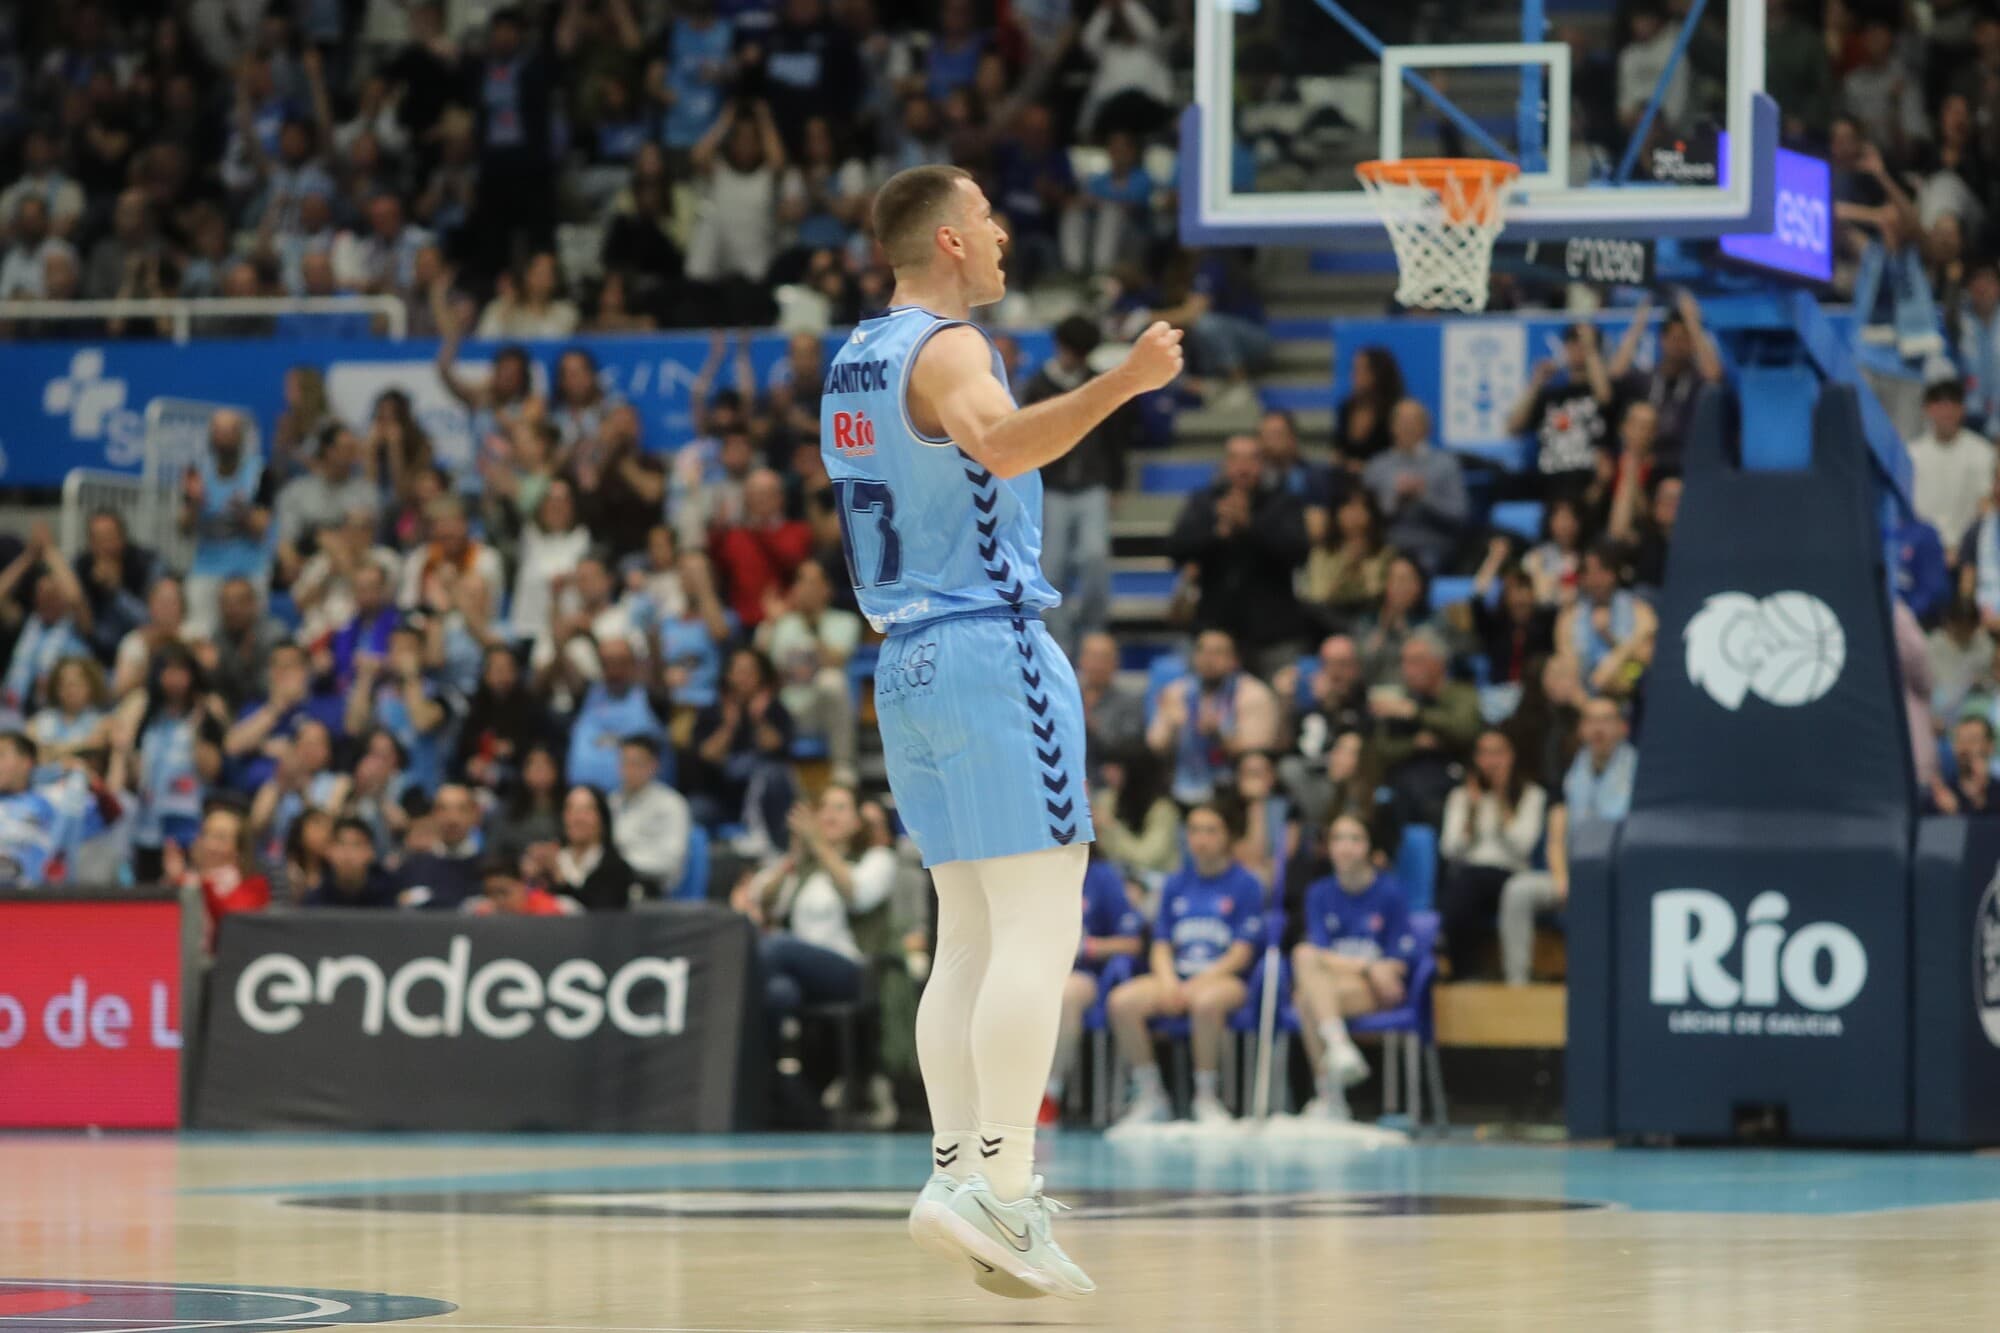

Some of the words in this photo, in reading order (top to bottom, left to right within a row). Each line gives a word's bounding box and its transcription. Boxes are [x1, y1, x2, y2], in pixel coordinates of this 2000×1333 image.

[1775, 188, 1830, 255] esa
[235, 934, 691, 1040] endesa
[1650, 887, 1868, 1012] Río
[43, 972, 133, 1049] de
[1668, 1011, 1732, 1034] LECHE
[1734, 1011, 1763, 1035] DE
